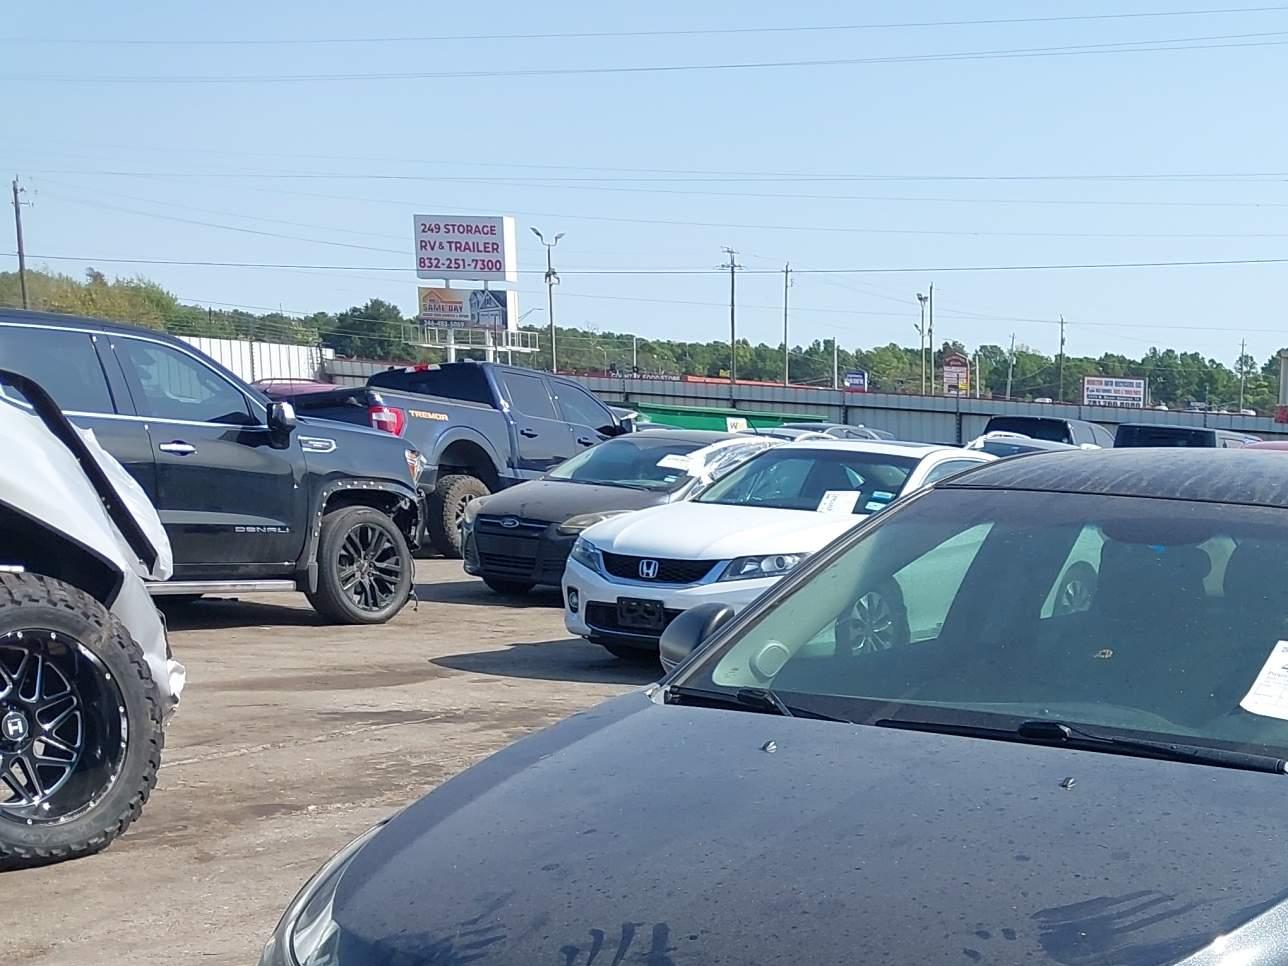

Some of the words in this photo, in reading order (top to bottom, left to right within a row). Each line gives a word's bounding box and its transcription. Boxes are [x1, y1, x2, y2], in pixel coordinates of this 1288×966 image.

[421, 223, 441, 234] 249
[444, 224, 497, 236] STORAGE
[420, 240, 437, 251] RV
[438, 241, 445, 250] &
[447, 241, 500, 254] TRAILER
[418, 257, 502, 271] 832-251-7300
[423, 303, 447, 312] SAME
[448, 304, 463, 313] DAY
